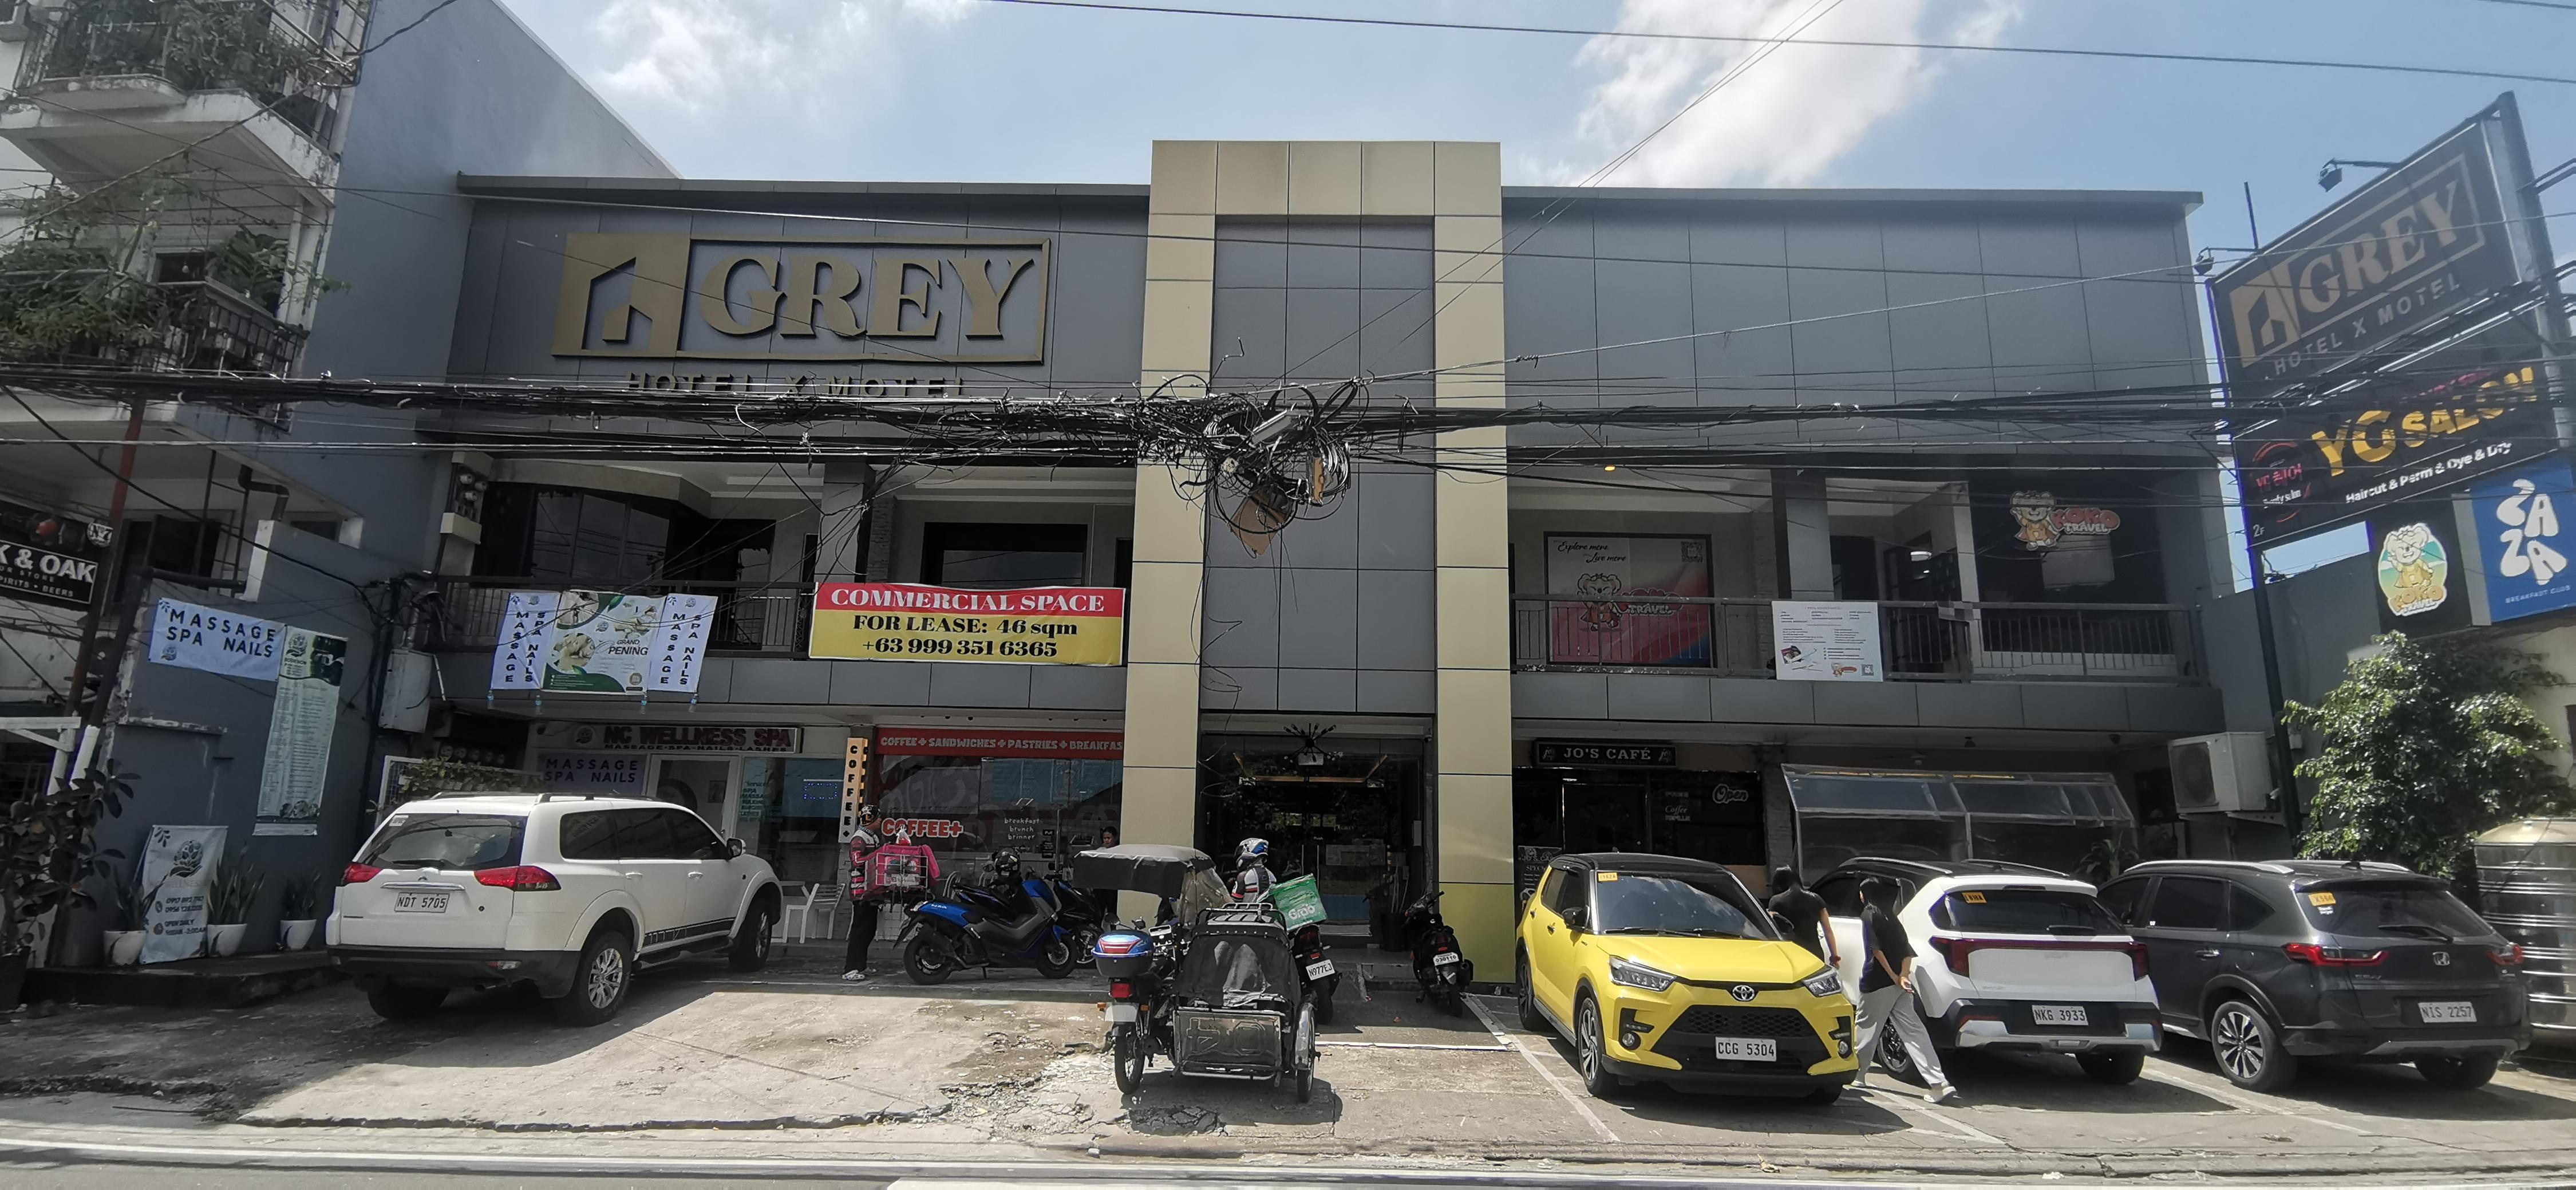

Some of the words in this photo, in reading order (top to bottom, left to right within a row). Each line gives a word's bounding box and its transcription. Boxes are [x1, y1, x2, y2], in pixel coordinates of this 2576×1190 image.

[2299, 179, 2459, 313] GREY
[699, 255, 1036, 339] GREY
[2274, 332, 2342, 376] HOTEL
[2352, 317, 2366, 338] X
[2377, 273, 2460, 325] MOTEL
[2346, 486, 2388, 504] Haircut
[2388, 479, 2399, 490] &
[2400, 467, 2433, 487] Perm
[2435, 463, 2447, 474] &
[2447, 454, 2473, 471] Dye
[2474, 449, 2486, 460] &
[2487, 440, 2512, 459] Dry
[2051, 507, 2119, 529] KOKO
[2064, 521, 2108, 532] TRAVEL
[2253, 523, 2265, 538] 2F
[1558, 541, 1587, 553] Explore
[14, 549, 33, 569] &
[39, 555, 96, 583] OAK
[1585, 552, 1604, 563] Live
[42, 585, 73, 597] BEERS
[2550, 584, 2571, 594] CLUB
[831, 588, 1014, 611] COMMERCIAL
[1020, 594, 1105, 612] SPACE
[169, 608, 276, 643] MASSAGE
[532, 612, 546, 636] SPA
[688, 614, 702, 639] SPA
[853, 614, 902, 631] FOR
[906, 617, 988, 634] LEASE:
[996, 619, 1026, 635] 46
[1030, 621, 1077, 639] sqm
[167, 626, 203, 647] SPA
[223, 637, 273, 658] NAILS
[505, 612, 529, 683] MASSAGE
[660, 613, 686, 684] MASSAGE
[862, 637, 903, 653] +63
[907, 639, 953, 654] 999
[957, 640, 994, 655] 351
[999, 640, 1058, 657] 6365
[525, 644, 539, 682] NAILS
[679, 647, 695, 684] NAILS
[604, 726, 633, 744] NC
[639, 727, 746, 746] WELLNESS
[753, 728, 791, 747] SPA
[882, 737, 917, 746] COFFEE
[929, 738, 996, 748] SANDWICHES
[1007, 739, 1057, 750] PASTRIES
[1563, 747, 1599, 759] JO'S
[1606, 746, 1651, 760] CAFÉ
[546, 759, 638, 770] MASSAGE
[544, 771, 574, 783] SPA
[591, 773, 636, 783] NAILS
[1712, 783, 1748, 804] Open
[1665, 805, 1688, 815] Coffee
[397, 896, 417, 908] NDT
[421, 897, 447, 909] 5705
[1289, 903, 1315, 920] Grab
[1435, 955, 1457, 963] 030110
[1309, 963, 1333, 977] N977EJ
[2034, 1009, 2054, 1021] NKG
[2059, 1010, 2086, 1022] 3933
[2421, 1007, 2442, 1018] NIS
[2449, 1006, 2472, 1018] 2257
[1718, 1042, 1739, 1055] CCG
[1747, 1043, 1774, 1057] 5304
